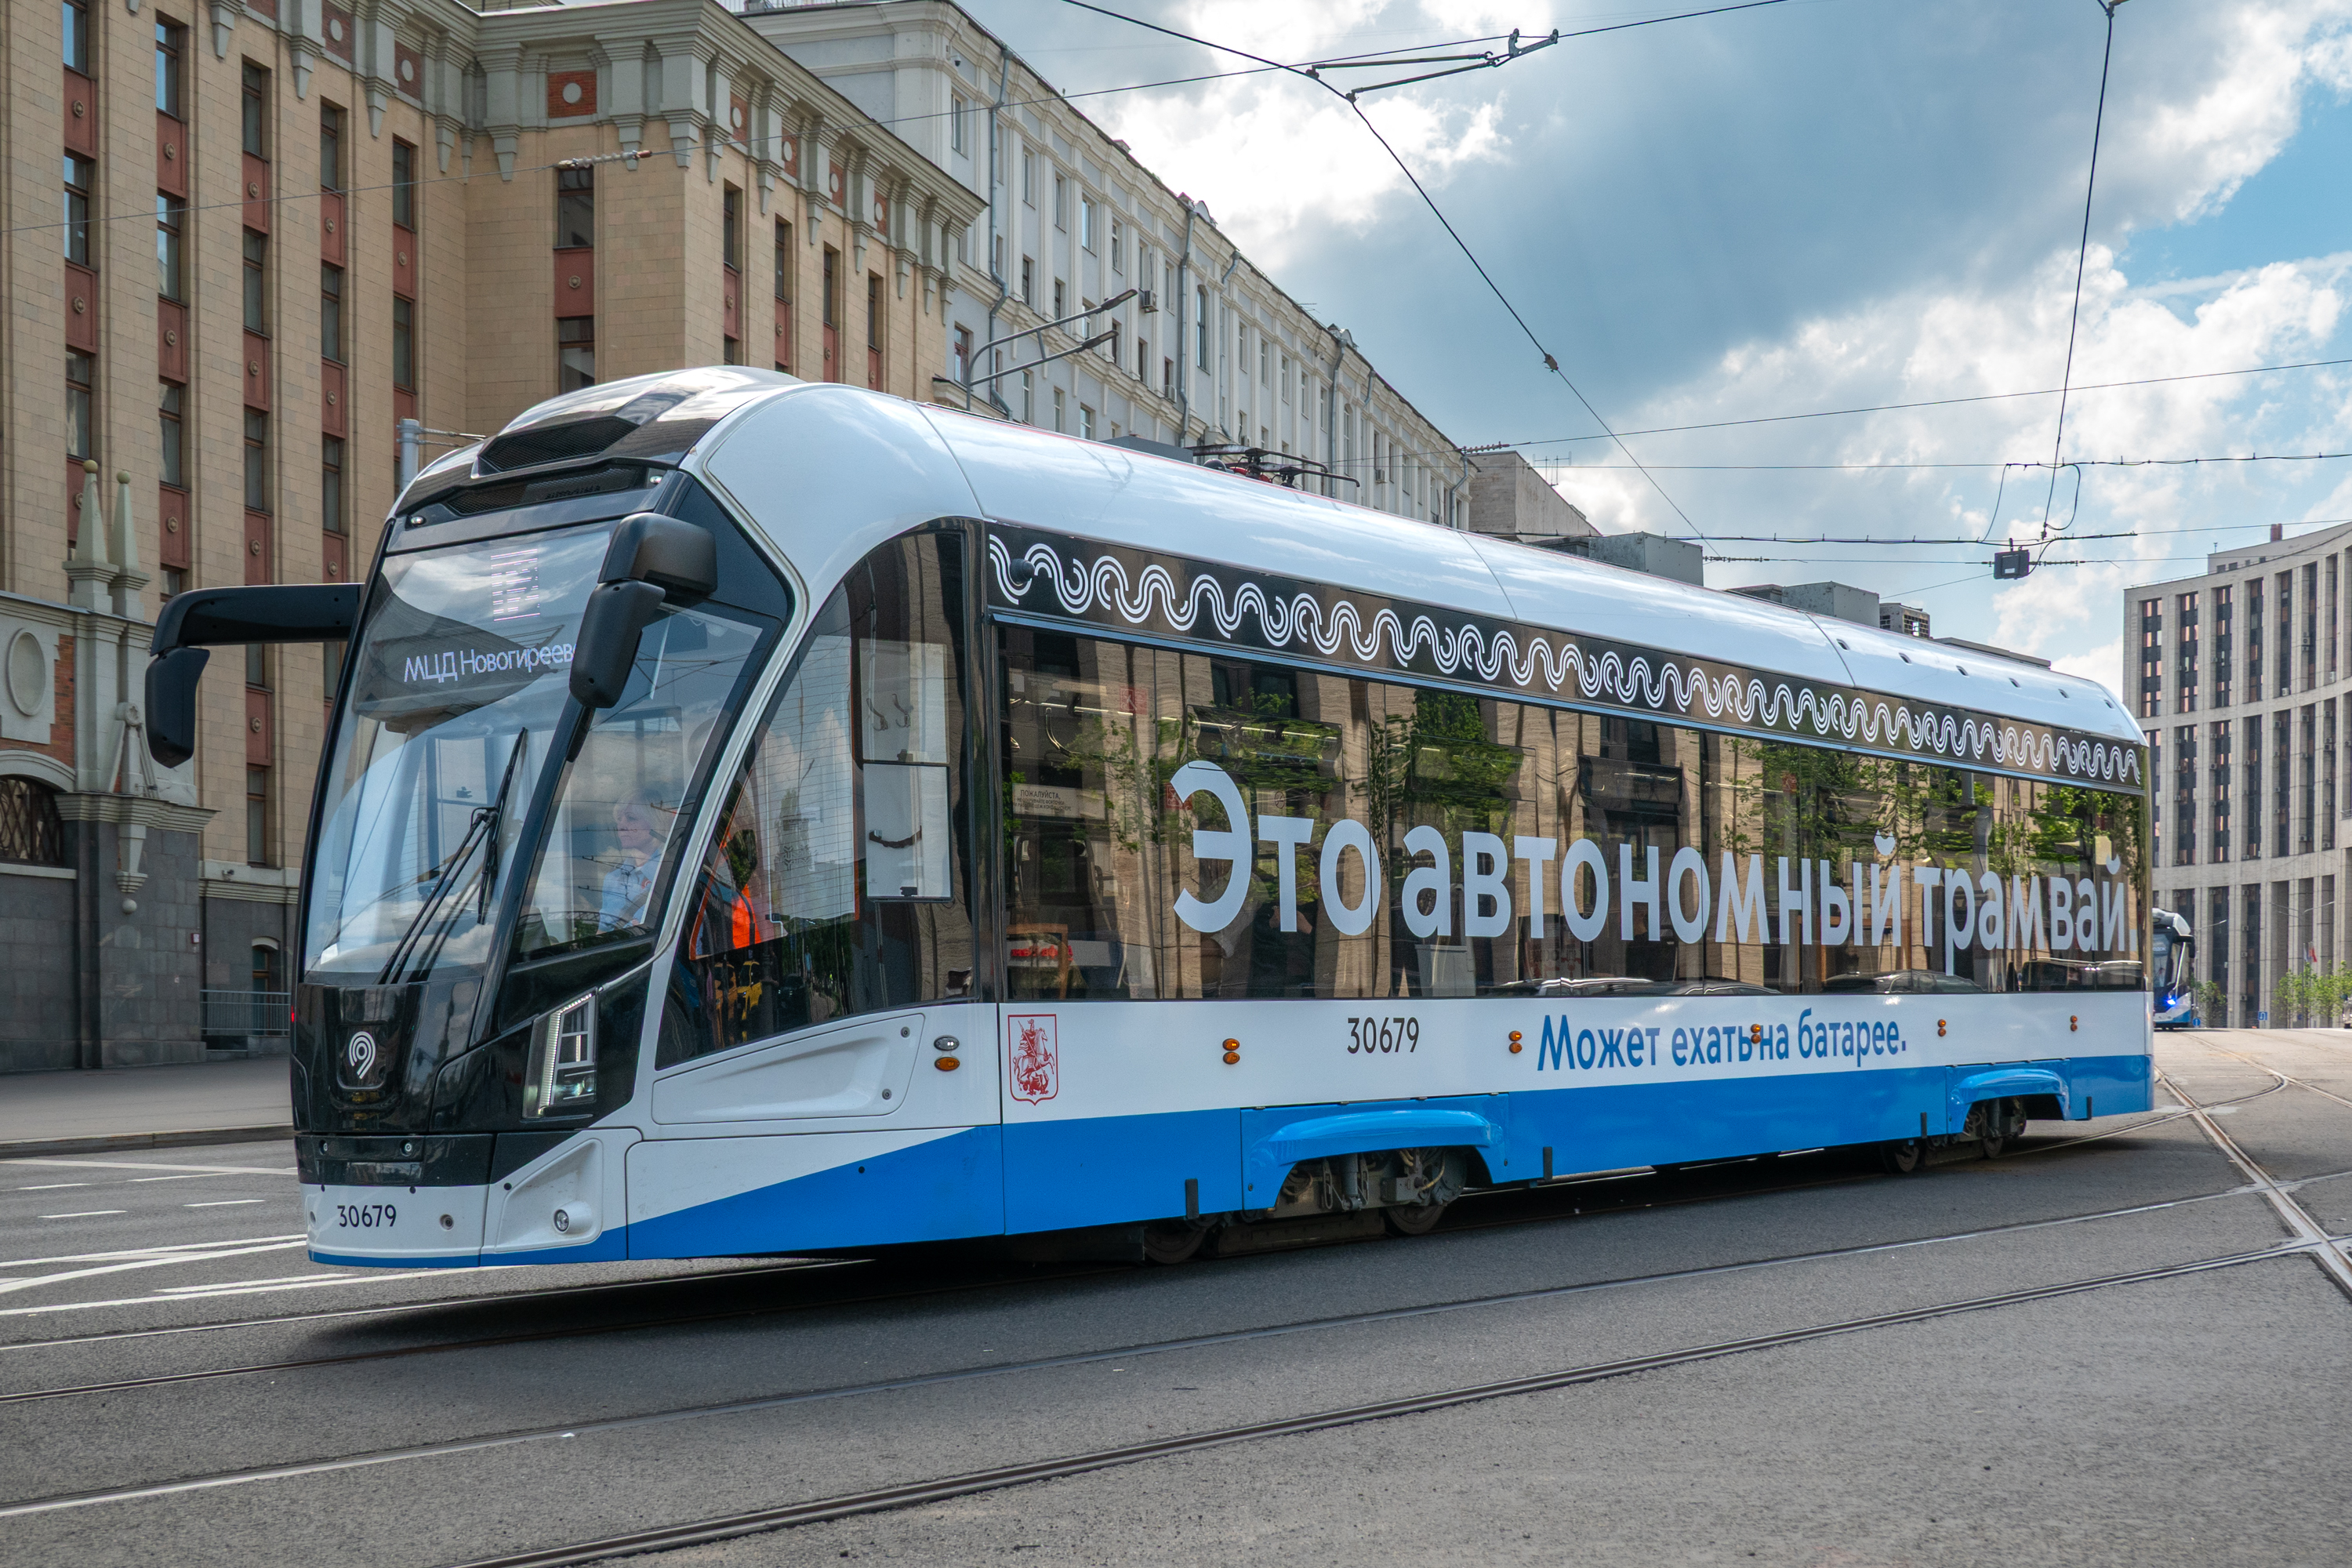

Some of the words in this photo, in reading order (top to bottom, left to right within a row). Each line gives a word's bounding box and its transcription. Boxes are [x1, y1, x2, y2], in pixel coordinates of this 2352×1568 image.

[405, 652, 458, 683] МЦД
[1020, 789, 1061, 800] ПОЖАЛУЙСТА,
[1170, 760, 1381, 936] Это
[1402, 825, 1902, 946] автономный
[1914, 854, 2138, 977] трамвай.
[1347, 1017, 1419, 1054] 30679
[1537, 1014, 1661, 1071] Может
[1671, 1025, 1752, 1066] ехать
[1759, 1025, 1789, 1062] на
[1798, 1007, 1907, 1067] батарее.
[337, 1204, 397, 1228] 30679
